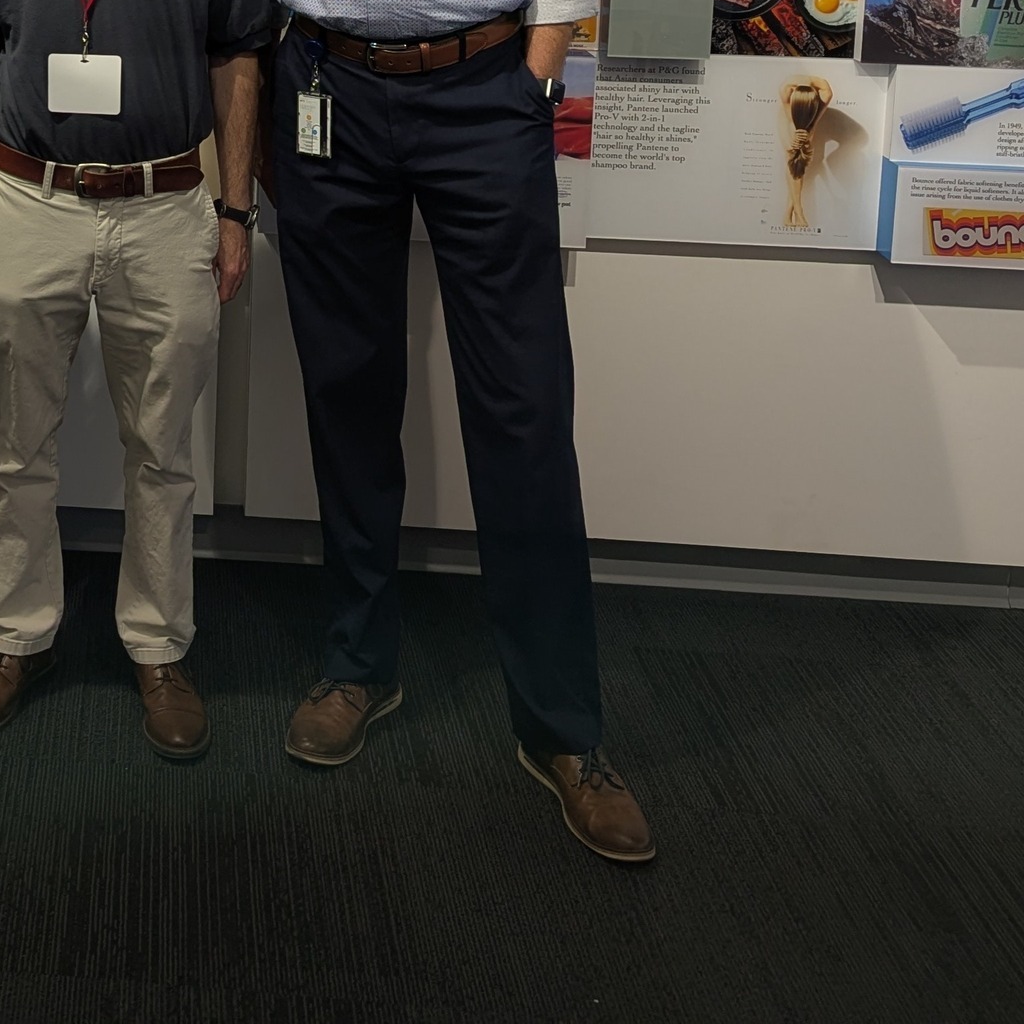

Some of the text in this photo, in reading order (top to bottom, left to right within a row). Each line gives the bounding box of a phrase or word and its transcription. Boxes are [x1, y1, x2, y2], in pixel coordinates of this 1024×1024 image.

[595, 93, 711, 105] healthy hair. Leveraging this
